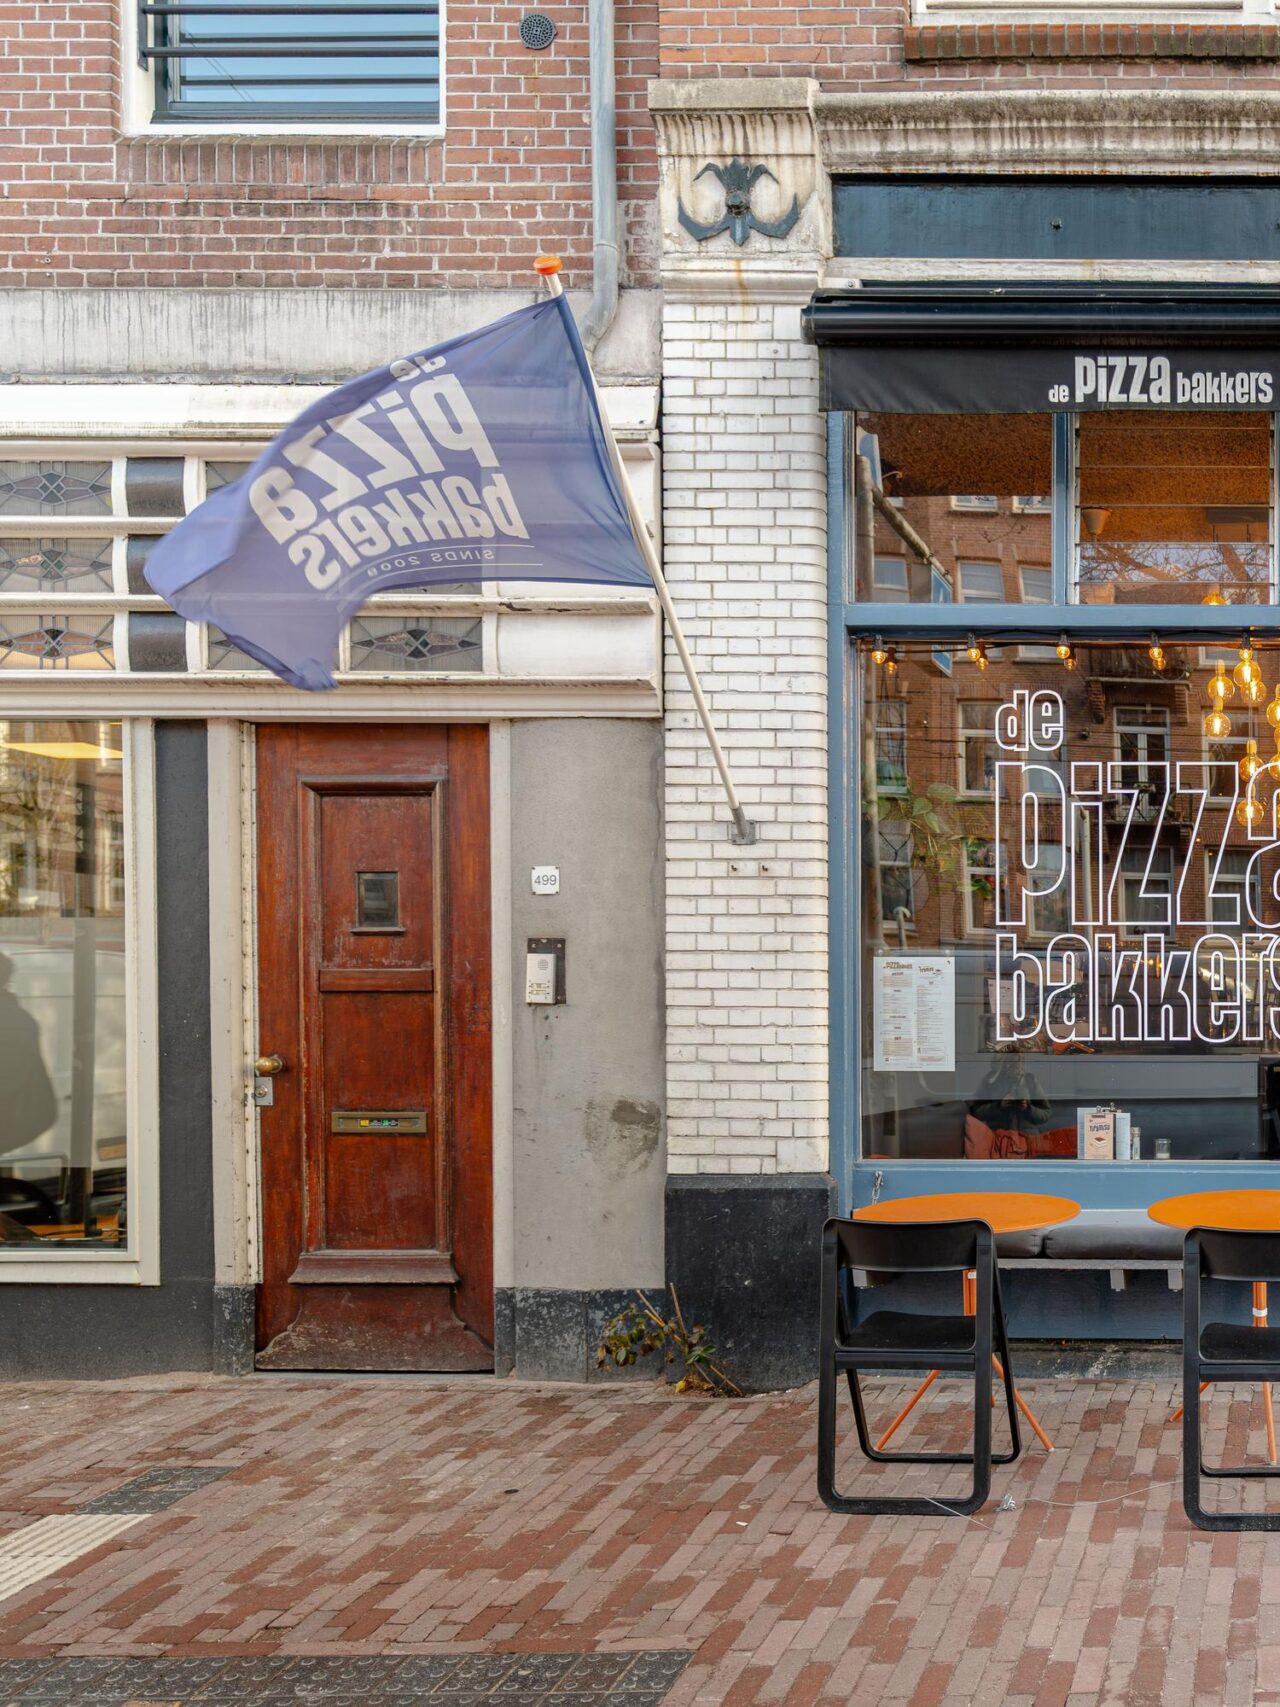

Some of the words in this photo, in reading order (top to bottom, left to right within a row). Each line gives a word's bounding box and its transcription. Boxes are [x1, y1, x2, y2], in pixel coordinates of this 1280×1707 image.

[1048, 385, 1069, 403] de
[1176, 372, 1273, 404] bakkers
[994, 689, 1065, 752] de
[534, 874, 557, 886] 499
